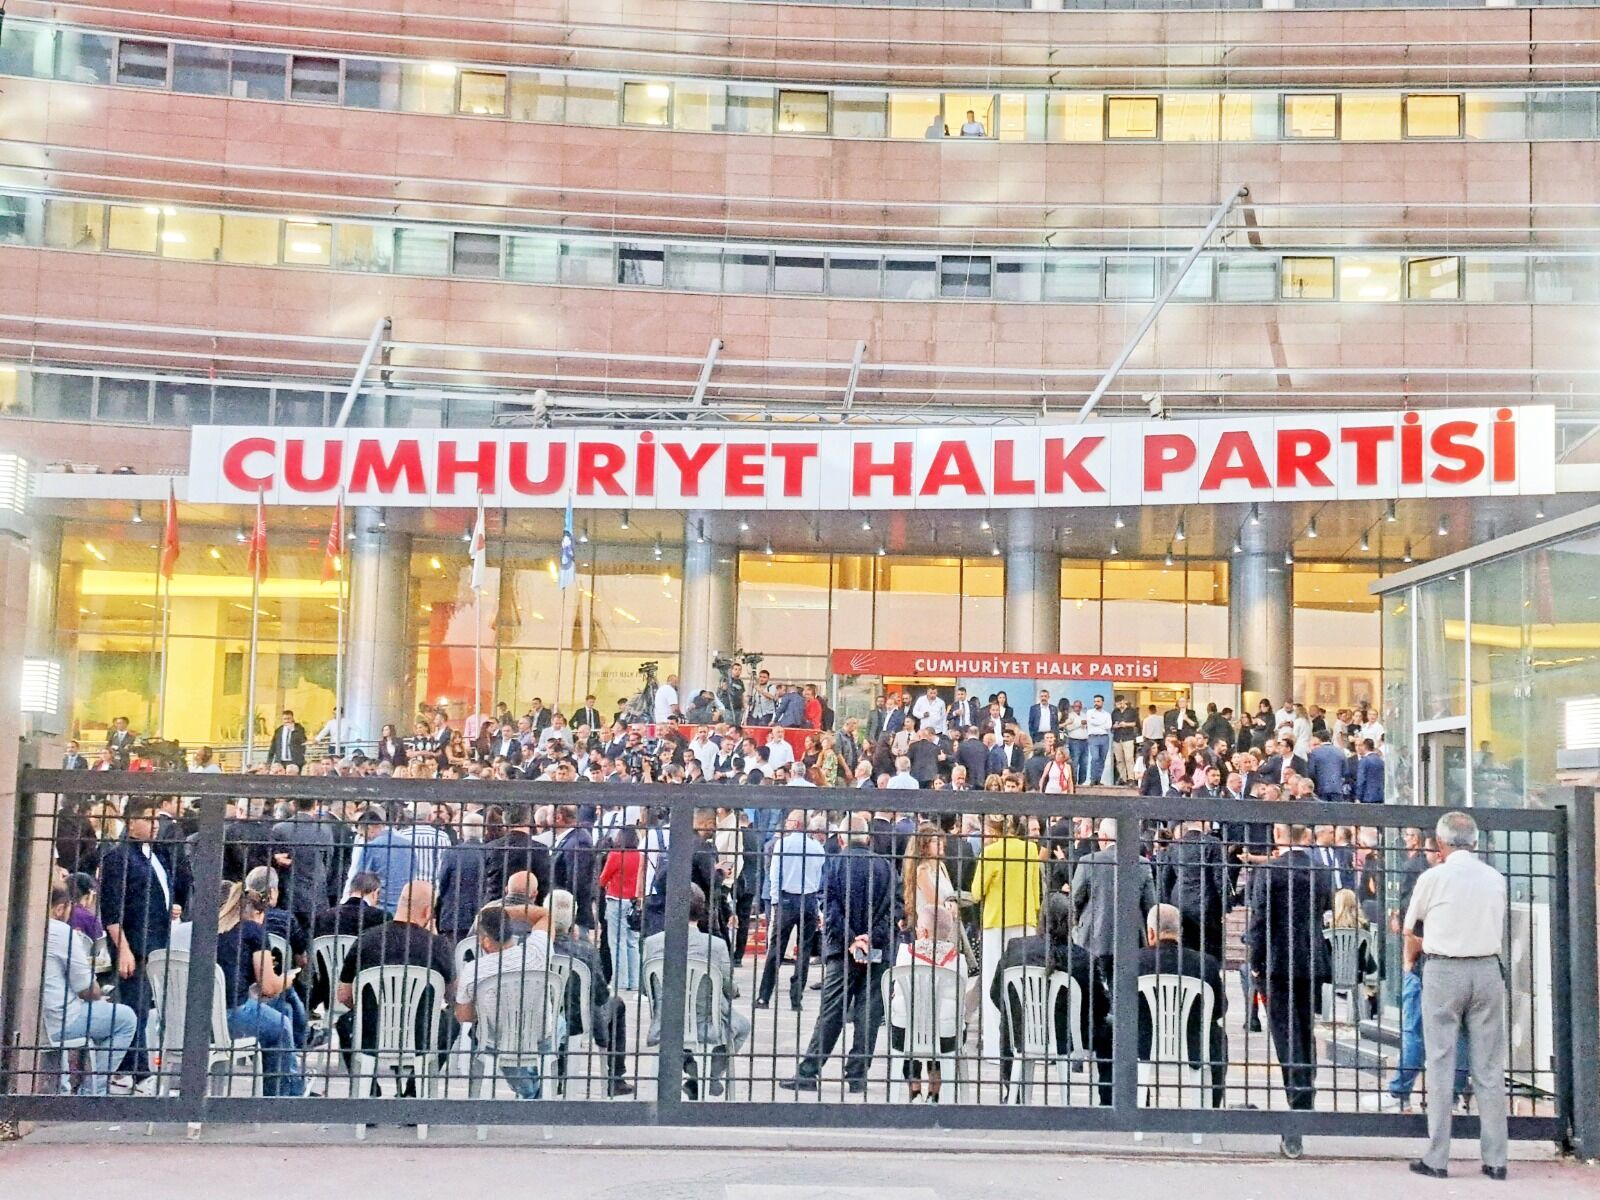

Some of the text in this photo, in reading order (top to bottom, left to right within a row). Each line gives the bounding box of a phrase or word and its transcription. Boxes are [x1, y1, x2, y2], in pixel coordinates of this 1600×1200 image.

[223, 409, 1516, 496] CUMHURİYET HALK PARTİSİ
[914, 656, 1158, 677] CUMHURİYET HALK PARTİSİ
